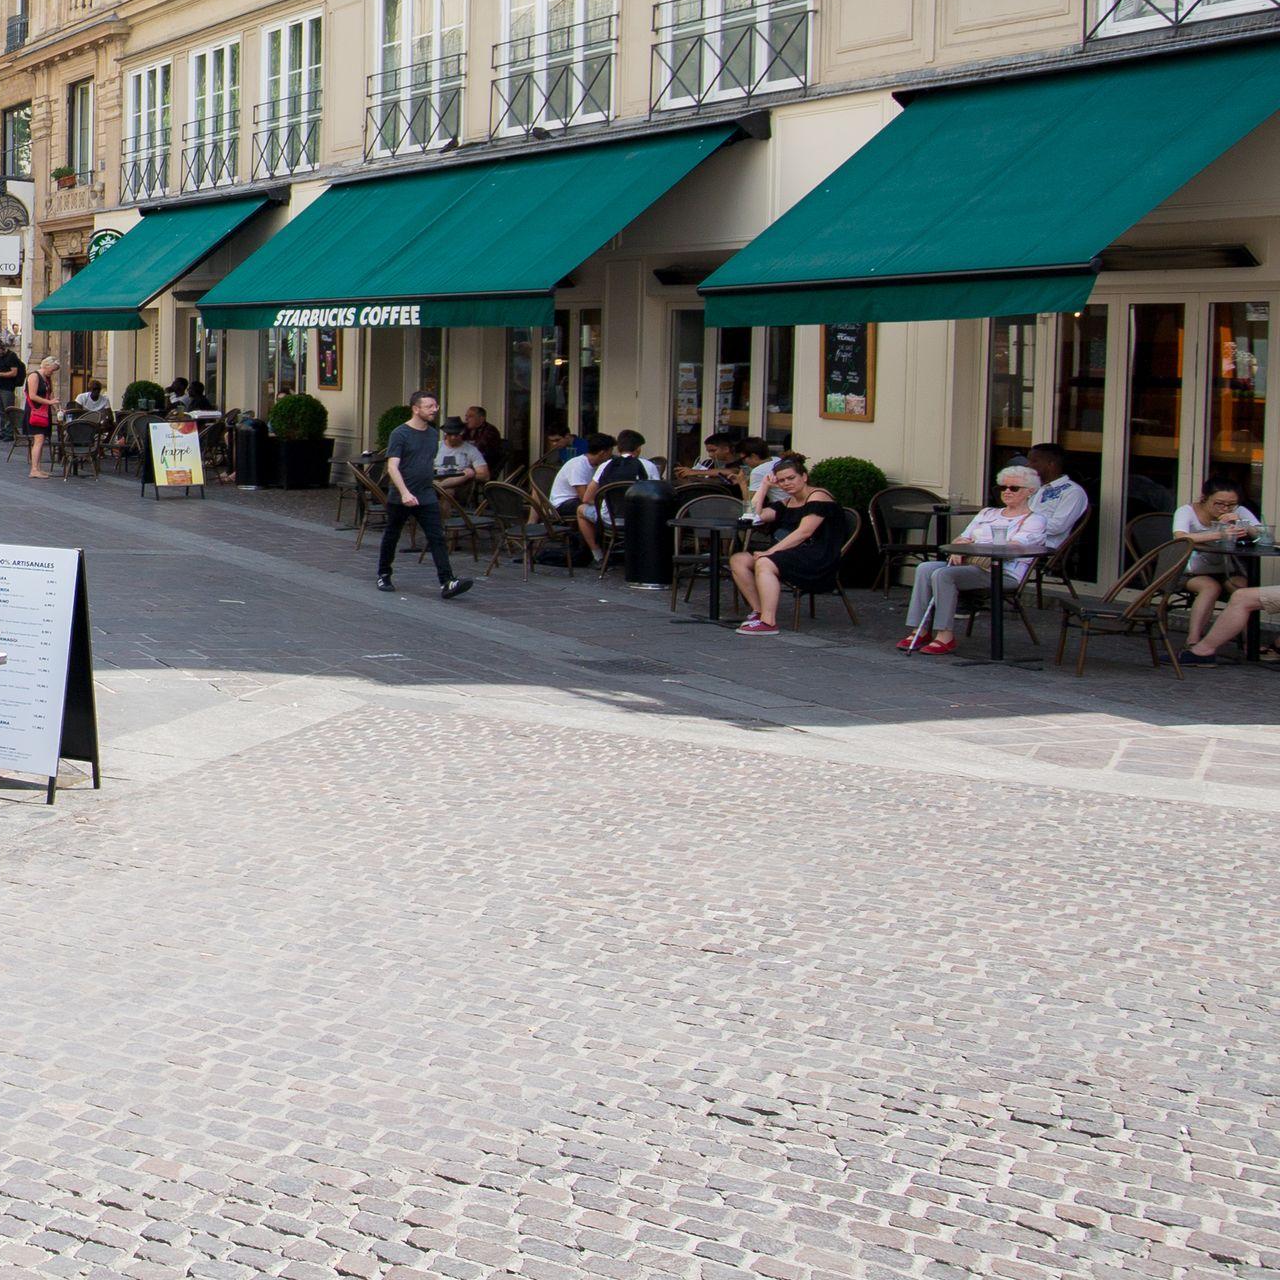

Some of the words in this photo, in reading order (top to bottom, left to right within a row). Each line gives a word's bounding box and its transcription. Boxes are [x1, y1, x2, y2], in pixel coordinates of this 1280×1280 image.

[273, 307, 357, 327] STARBUCKS
[360, 305, 421, 326] COFFEE
[12, 560, 55, 569] ARTISANALES
